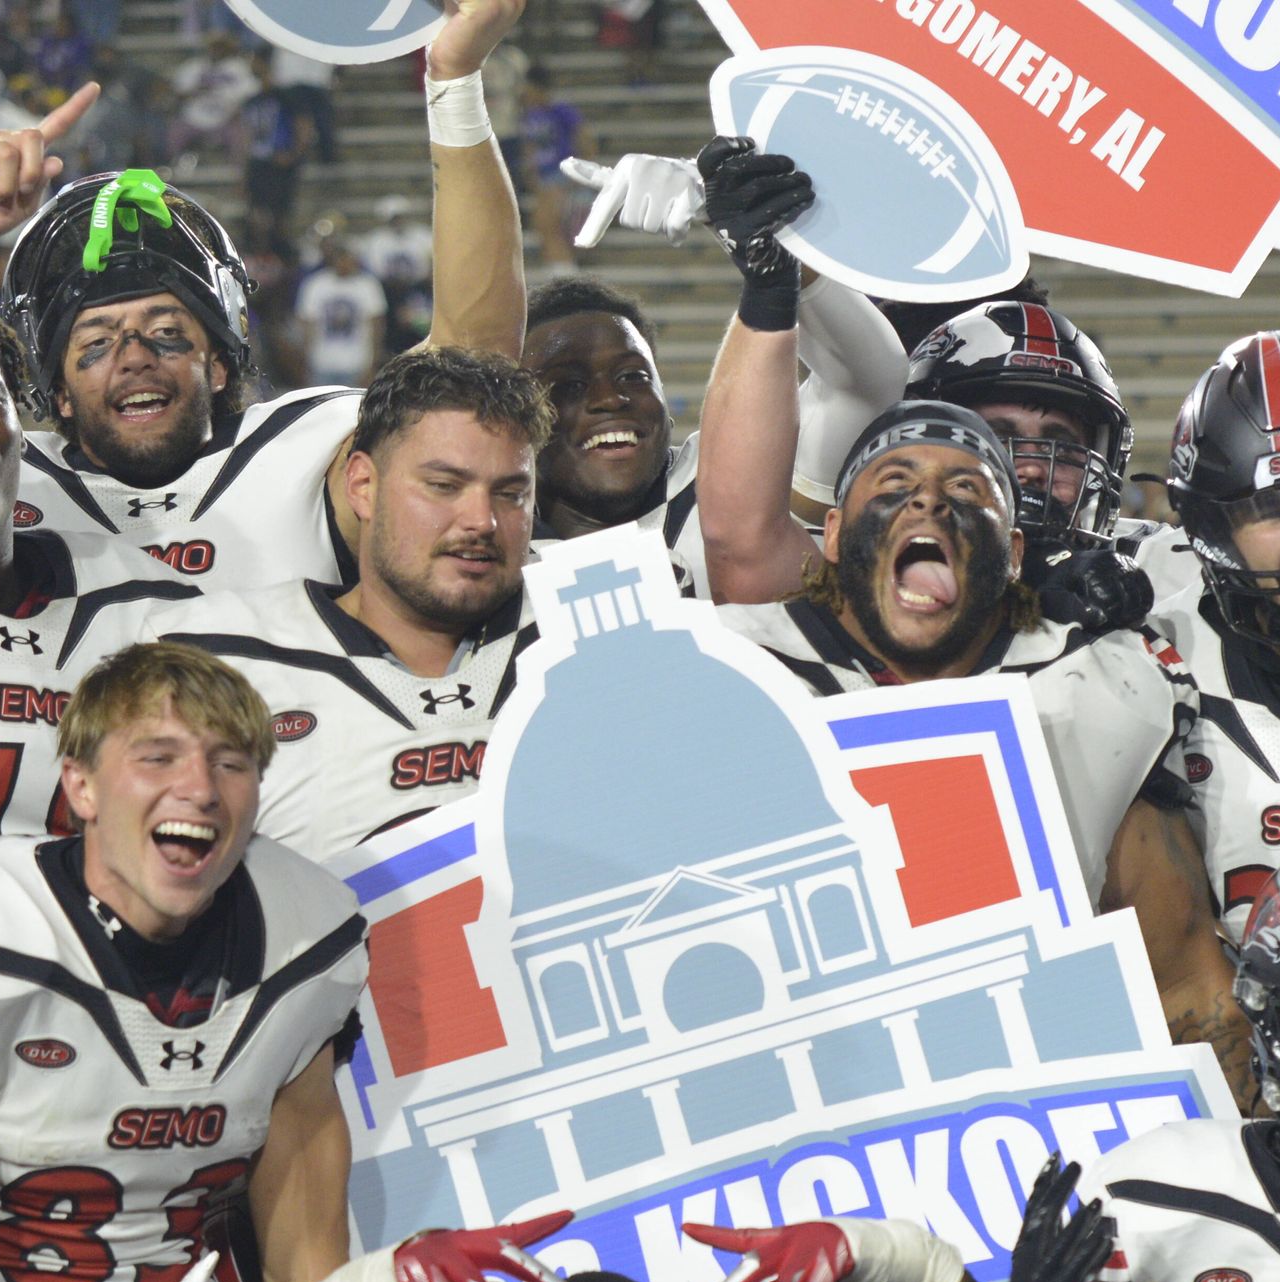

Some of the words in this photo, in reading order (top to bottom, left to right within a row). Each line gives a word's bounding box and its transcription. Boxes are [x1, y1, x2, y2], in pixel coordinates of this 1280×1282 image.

[880, 0, 1107, 145] GOMERY,
[1089, 108, 1166, 192] AL
[139, 540, 216, 575] MO
[275, 719, 302, 734] OVC
[391, 740, 488, 790] SEM
[28, 1047, 60, 1060] OVC
[107, 1103, 226, 1150] SEMO
